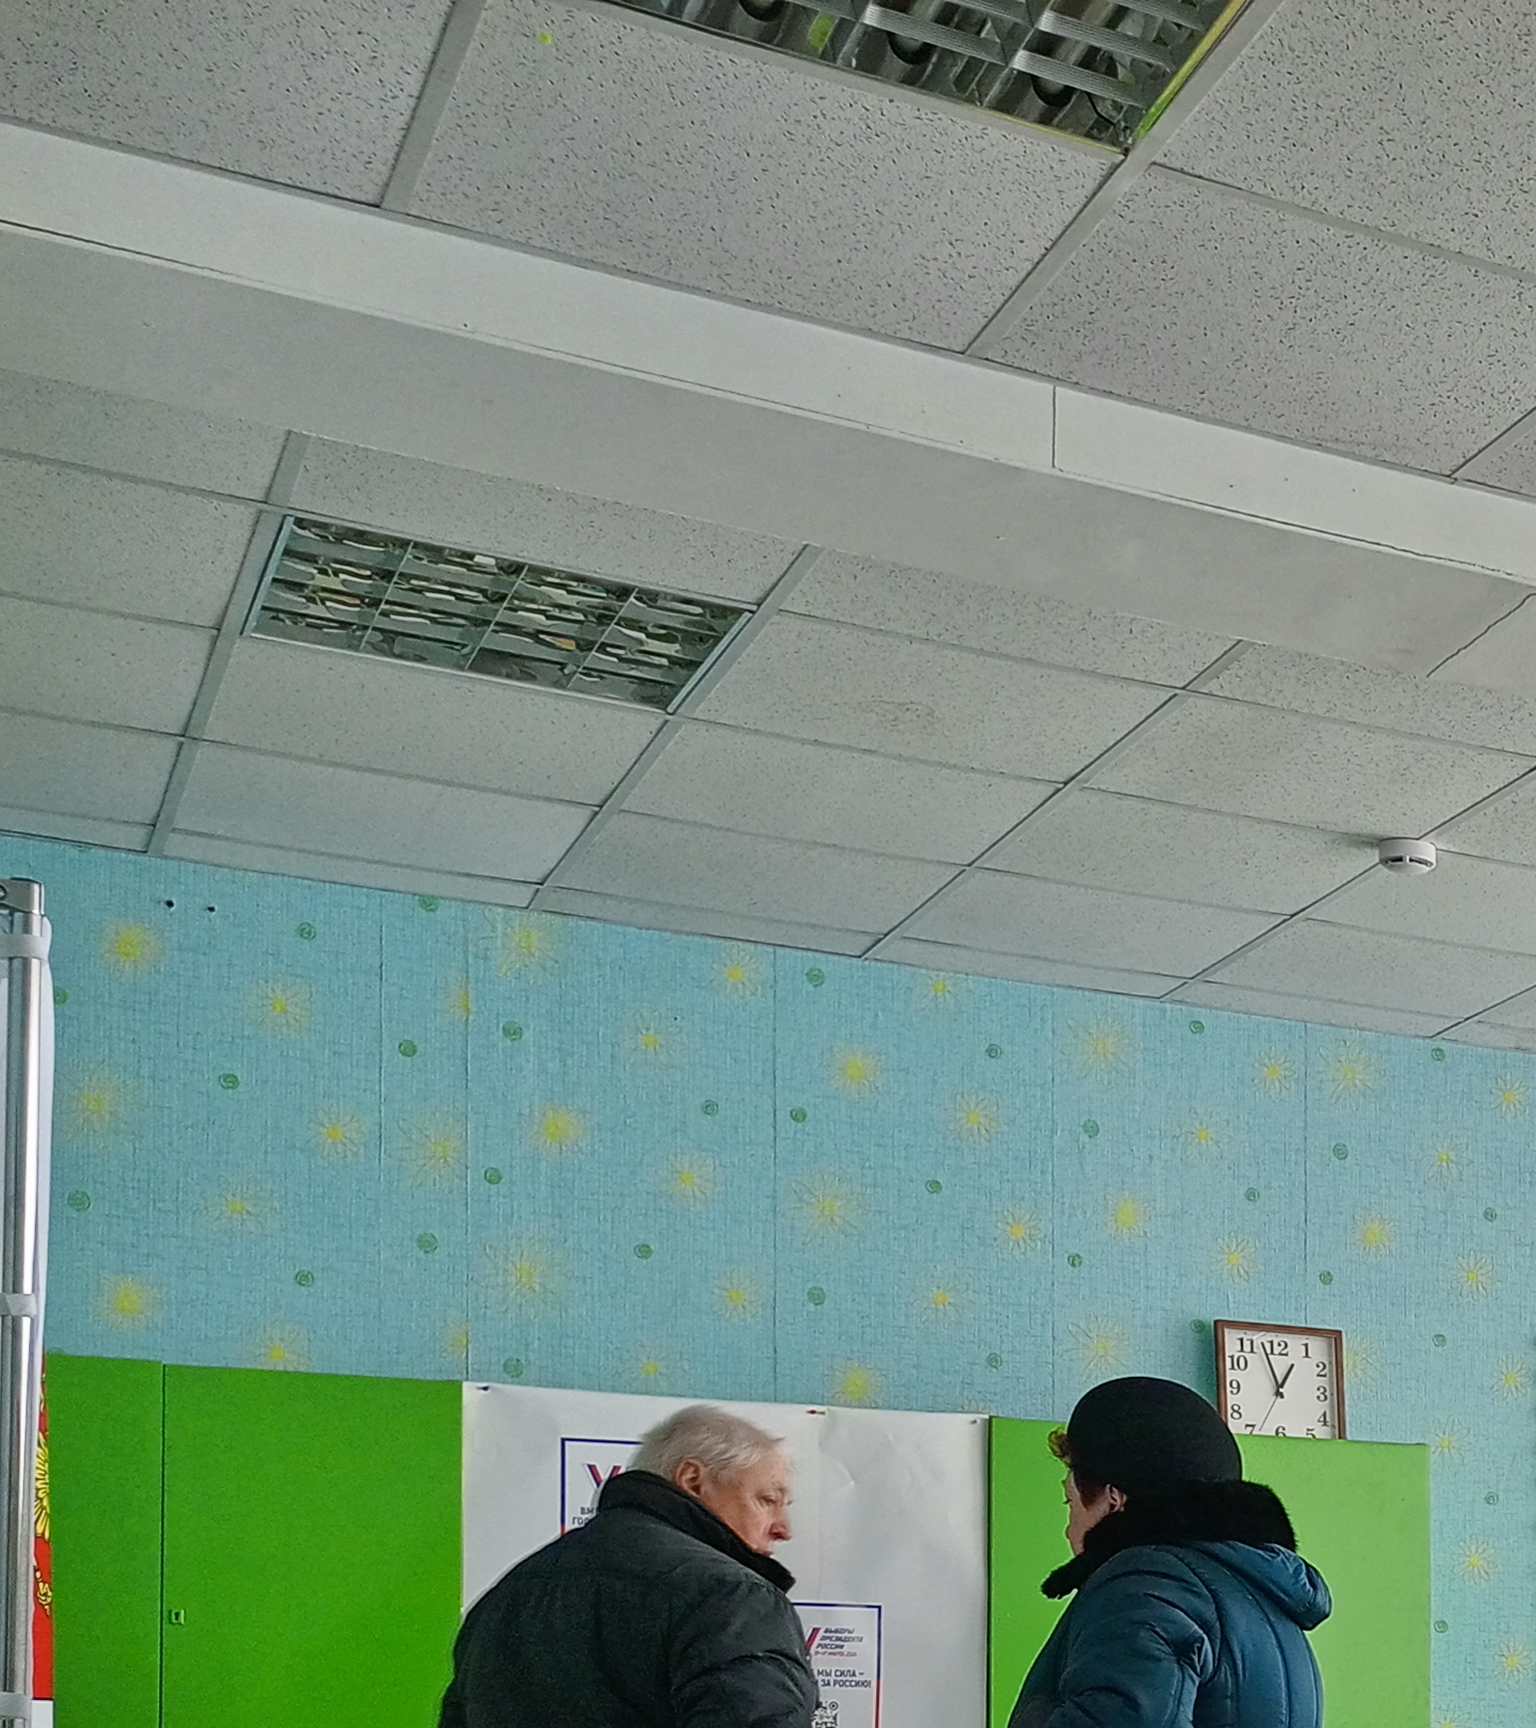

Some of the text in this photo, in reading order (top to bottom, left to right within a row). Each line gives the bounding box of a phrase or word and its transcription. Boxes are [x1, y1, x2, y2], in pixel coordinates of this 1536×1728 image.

[1237, 1337, 1289, 1356] 11 12
[1301, 1342, 1312, 1359] 1
[1228, 1355, 1248, 1371] 10
[1315, 1361, 1327, 1378] 2
[1229, 1378, 1241, 1395] 9
[1316, 1386, 1328, 1402] 3
[1230, 1403, 1243, 1420] 8
[1317, 1410, 1329, 1427] 4
